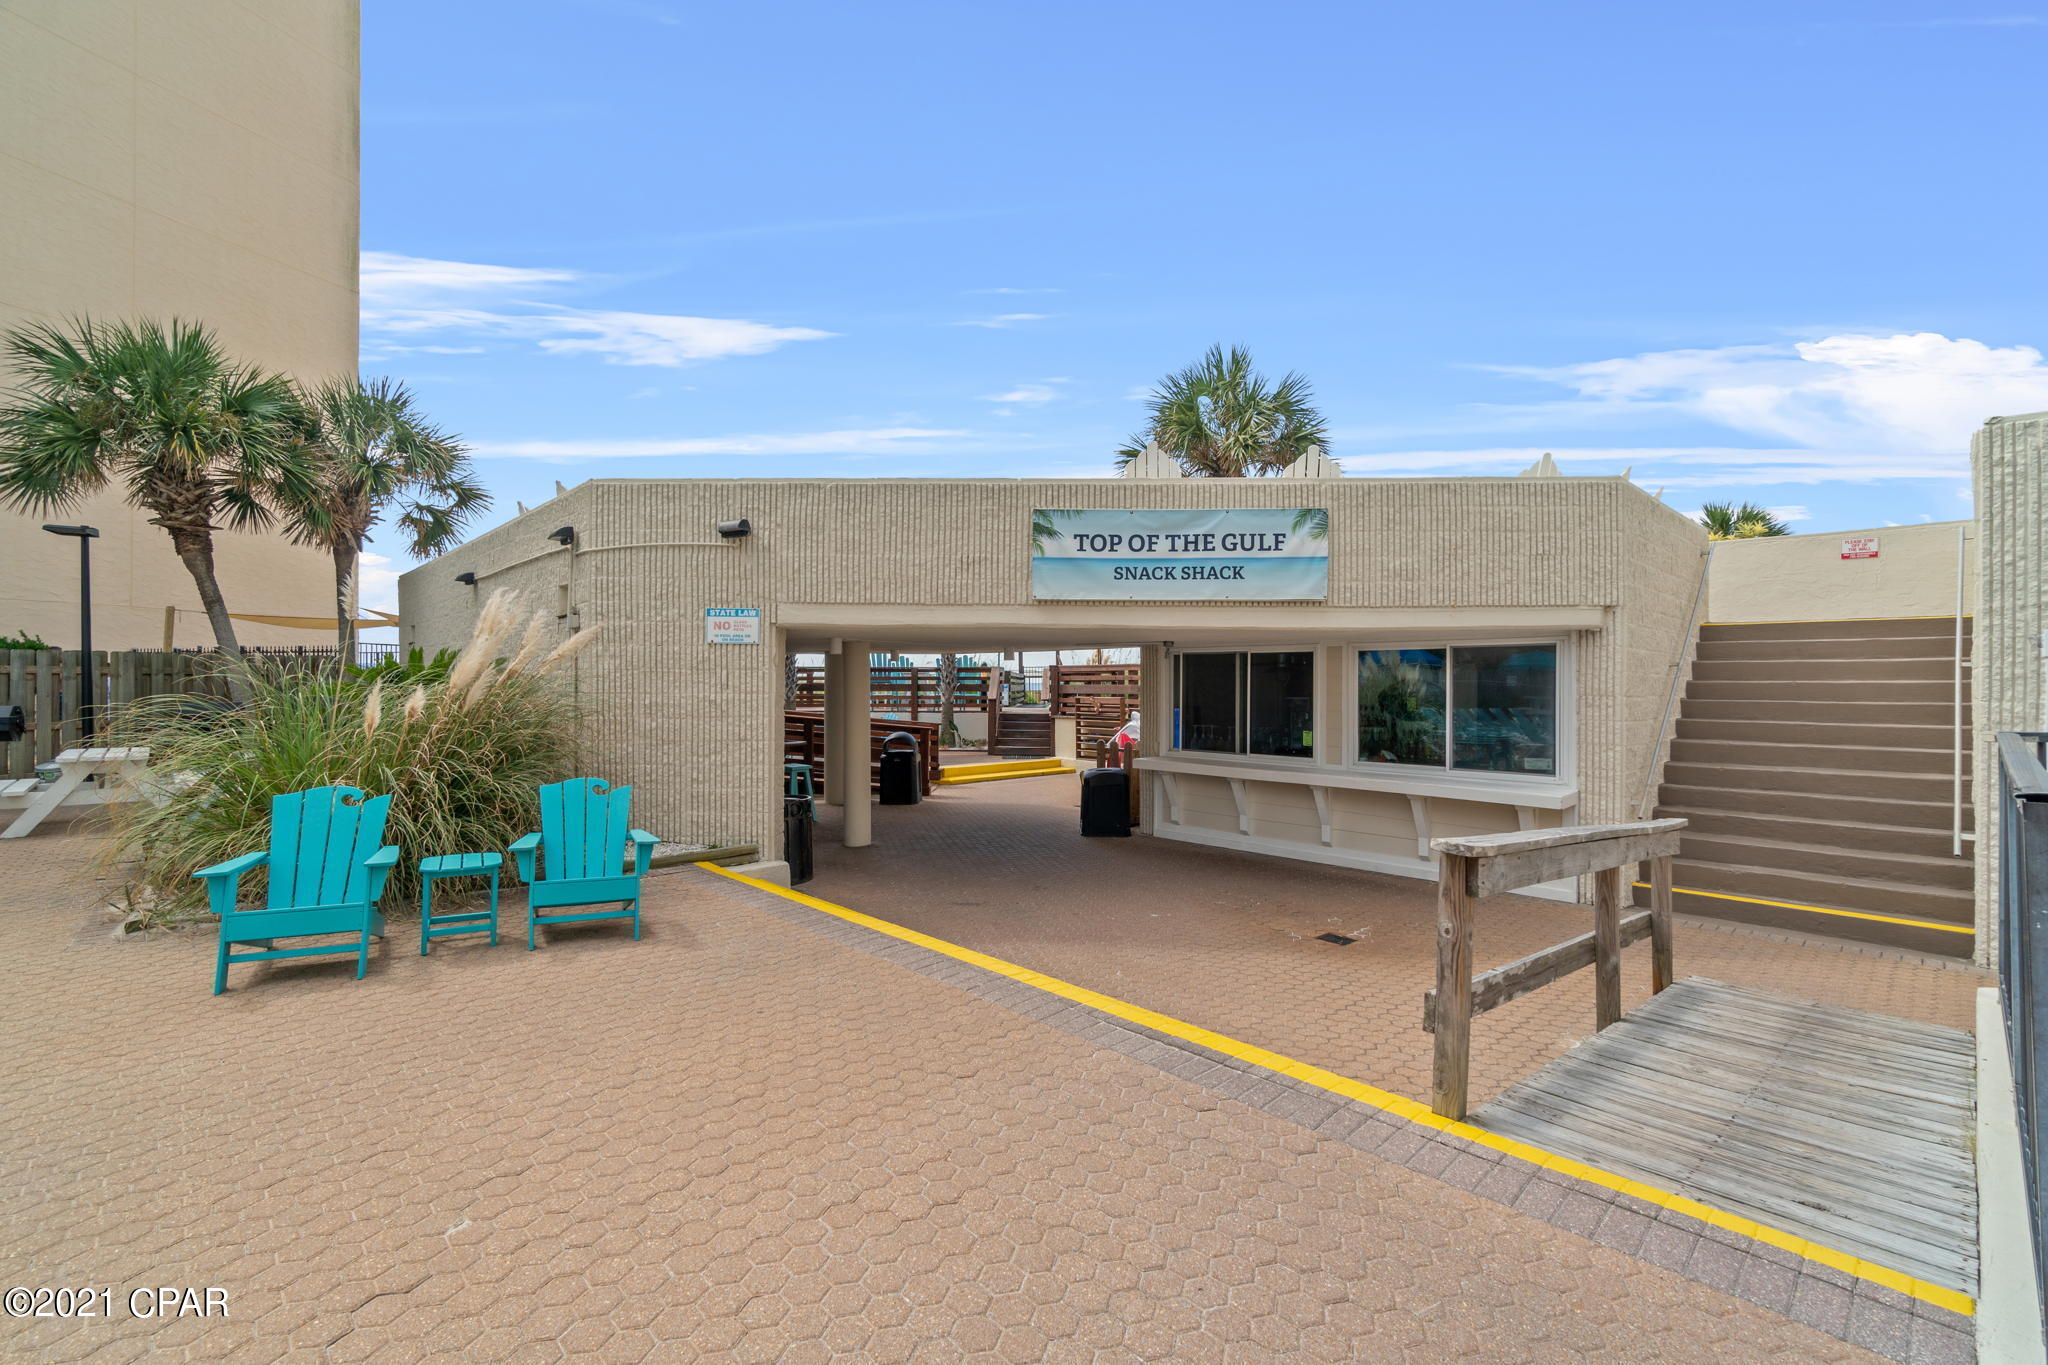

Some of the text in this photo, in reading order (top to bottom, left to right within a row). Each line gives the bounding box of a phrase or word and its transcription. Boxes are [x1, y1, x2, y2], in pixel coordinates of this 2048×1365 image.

[1073, 532, 1286, 553] TOP OF THE GULF
[1113, 565, 1245, 580] SNACK SHACK
[713, 621, 731, 631] NO
